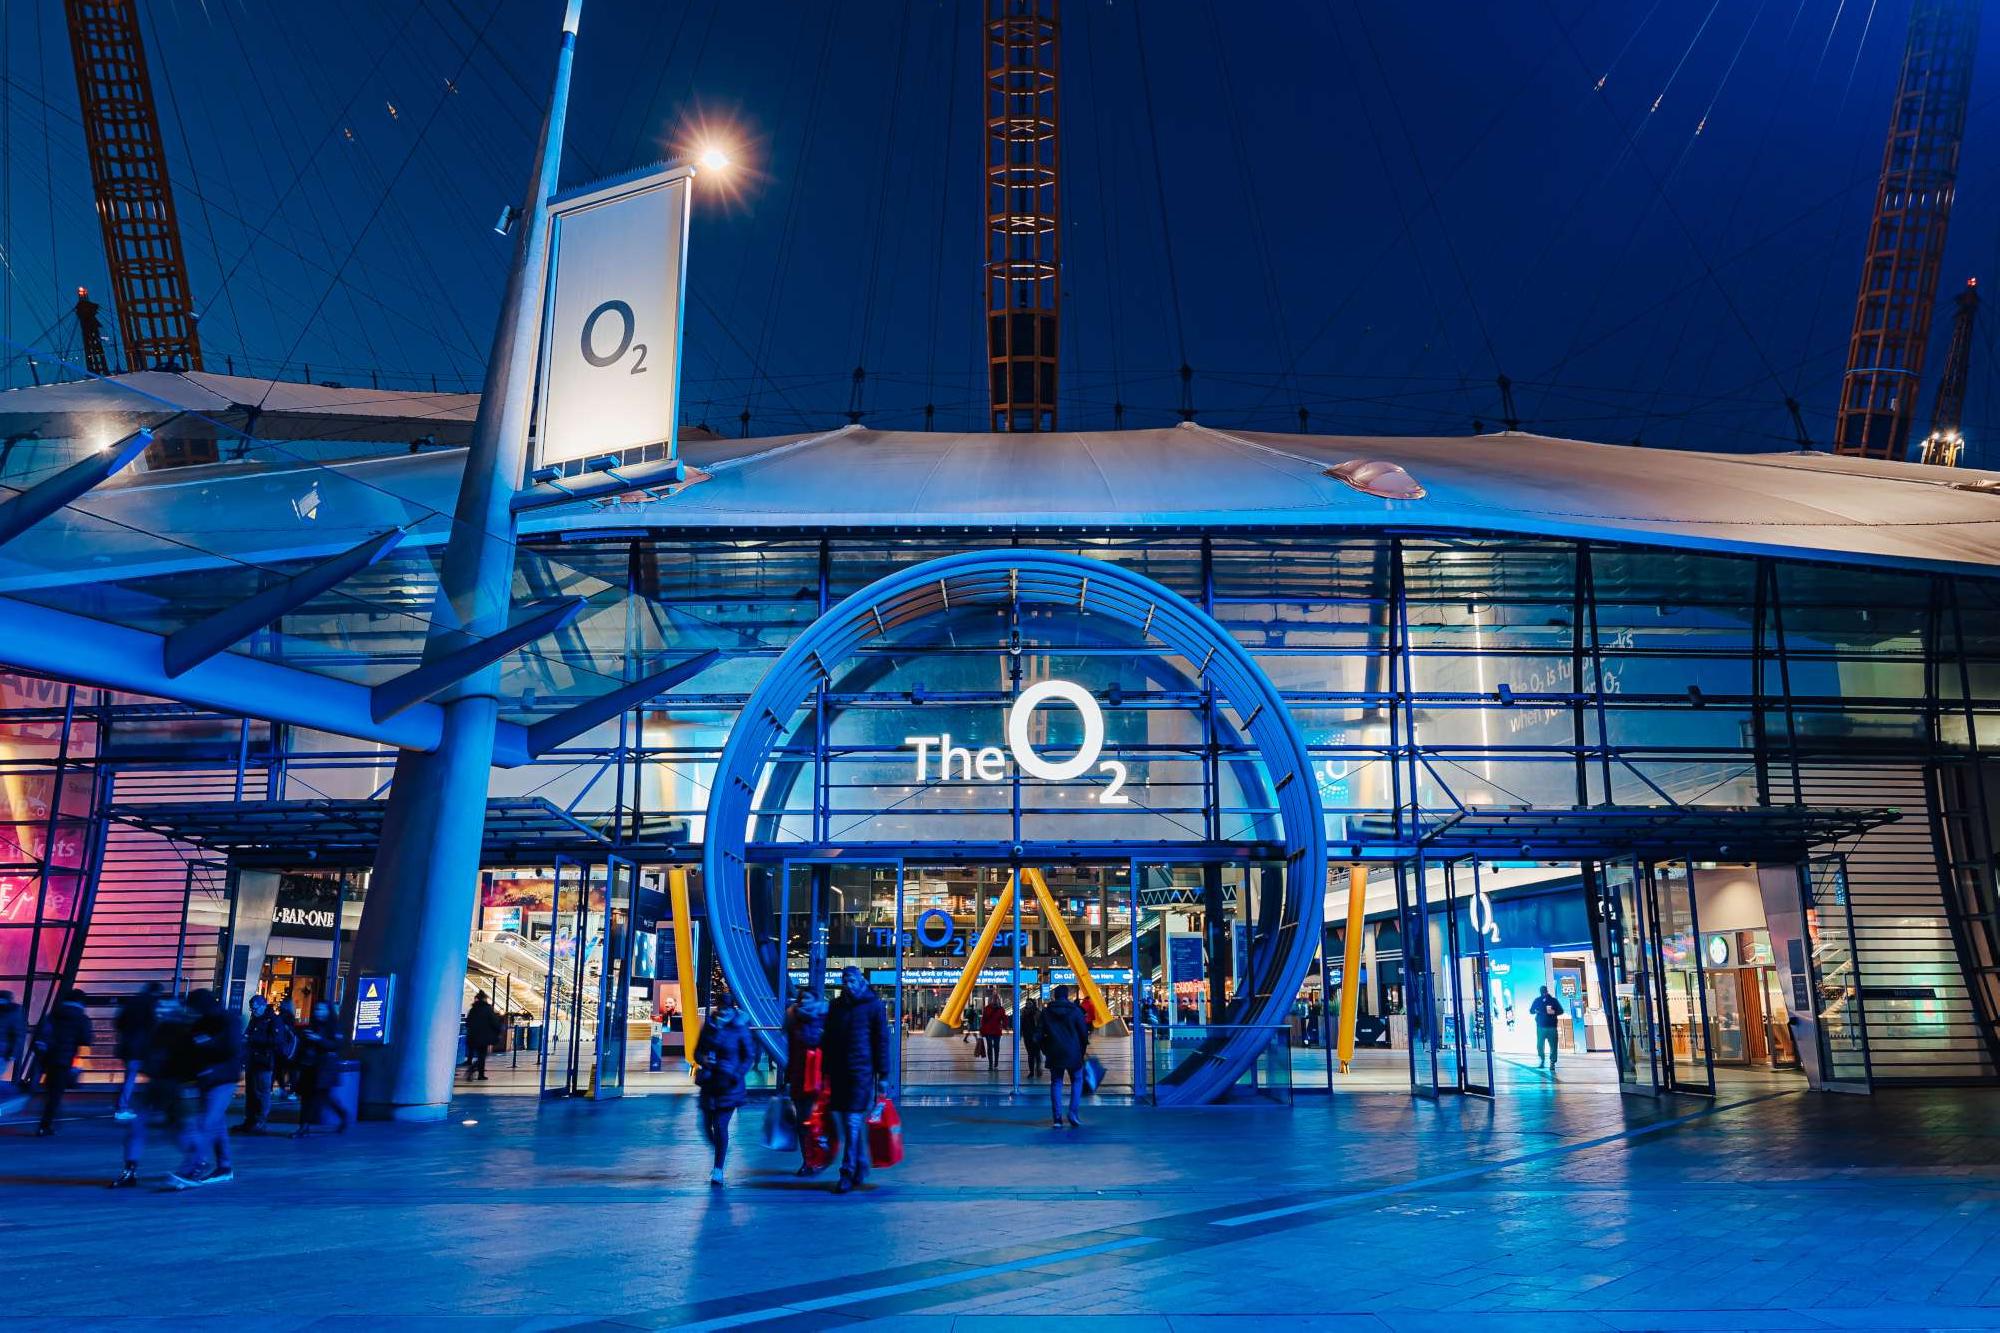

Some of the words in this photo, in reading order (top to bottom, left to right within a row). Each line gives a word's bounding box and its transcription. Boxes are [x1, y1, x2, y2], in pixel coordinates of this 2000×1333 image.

[580, 299, 648, 375] O2
[904, 734, 1005, 782] The
[1008, 680, 1130, 804] O2
[917, 908, 965, 956] O2
[968, 930, 1029, 948] aena
[1470, 892, 1501, 942] O2
